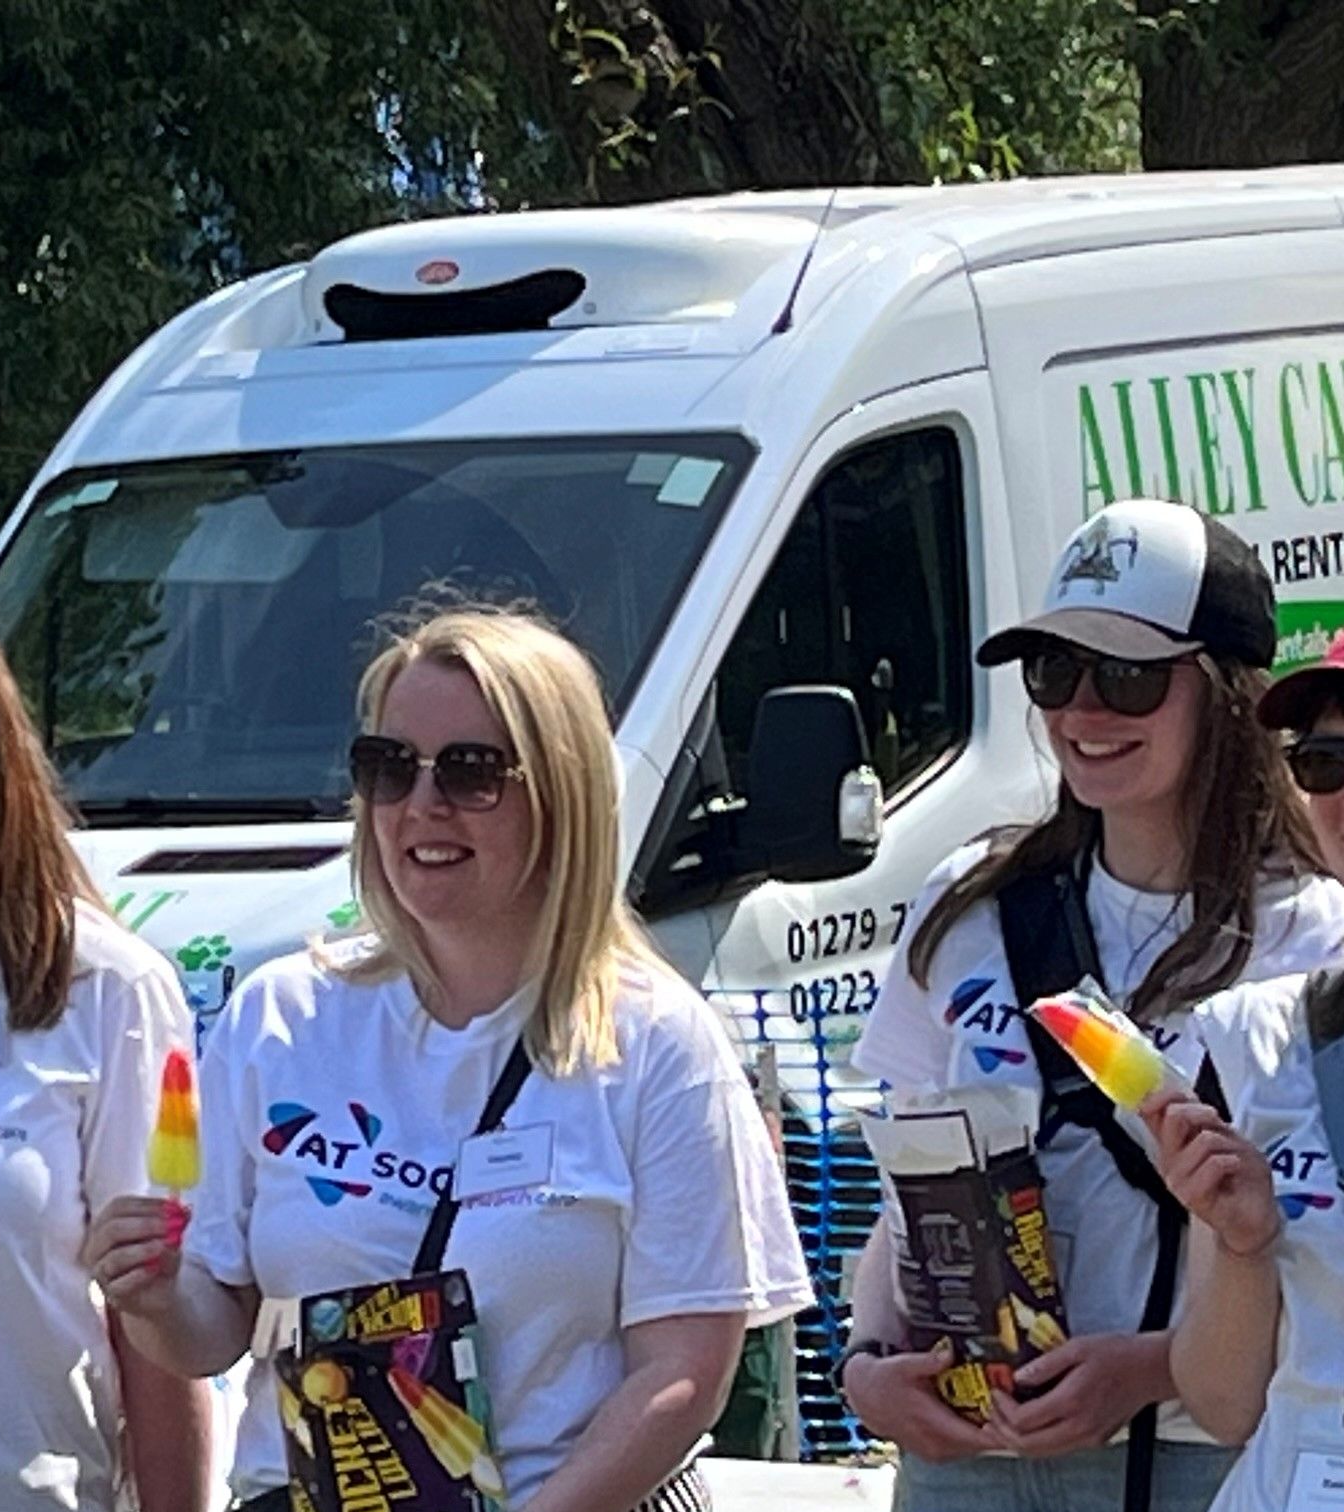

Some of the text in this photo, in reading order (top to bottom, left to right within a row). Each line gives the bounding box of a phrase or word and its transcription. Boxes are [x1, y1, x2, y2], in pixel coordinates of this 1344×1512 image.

[1078, 366, 1269, 522] ALLEY
[787, 907, 876, 963] 01279
[963, 1003, 1019, 1035] AT
[295, 1132, 361, 1170] AT
[1270, 1146, 1329, 1181] AT
